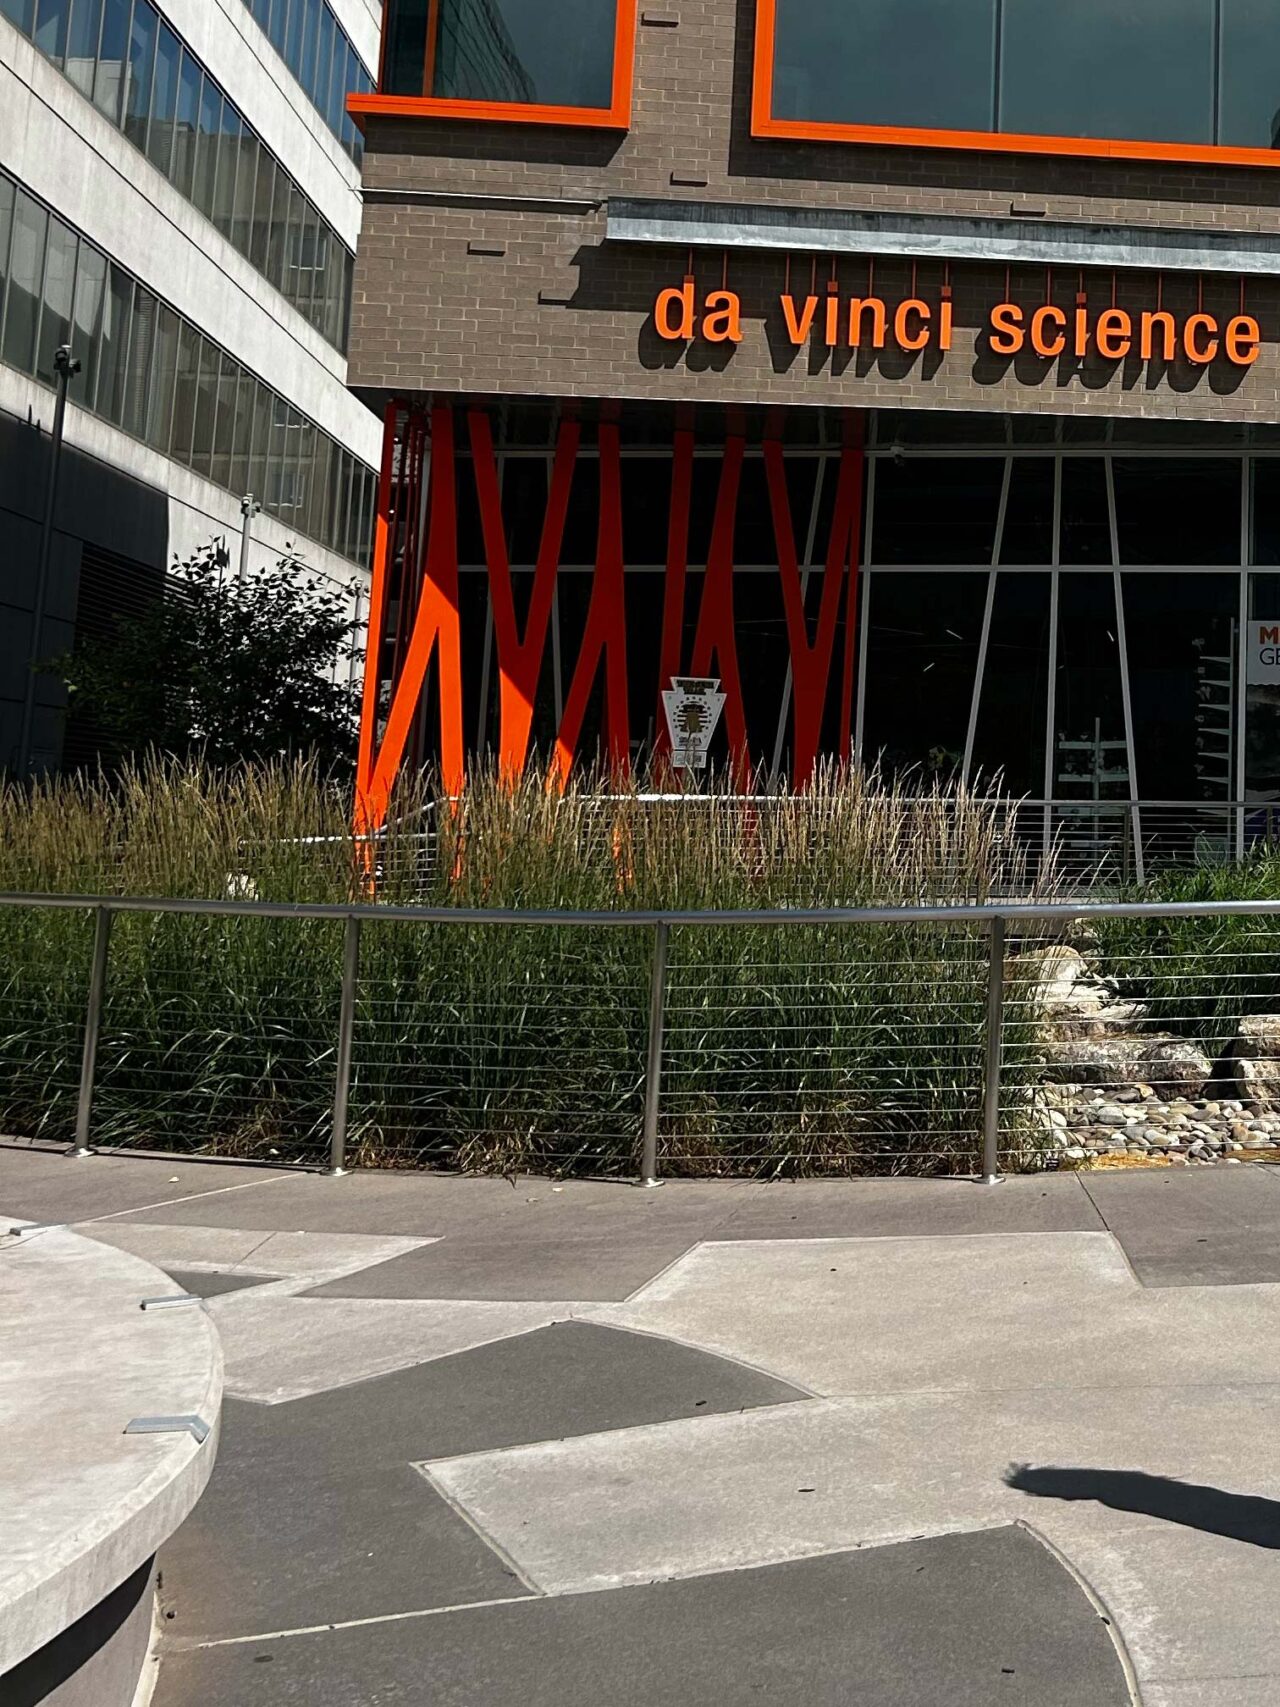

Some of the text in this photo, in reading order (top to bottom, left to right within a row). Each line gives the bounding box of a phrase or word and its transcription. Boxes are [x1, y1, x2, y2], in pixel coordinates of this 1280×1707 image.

[654, 275, 744, 343] da
[780, 282, 953, 350] vinci
[989, 294, 1260, 365] science
